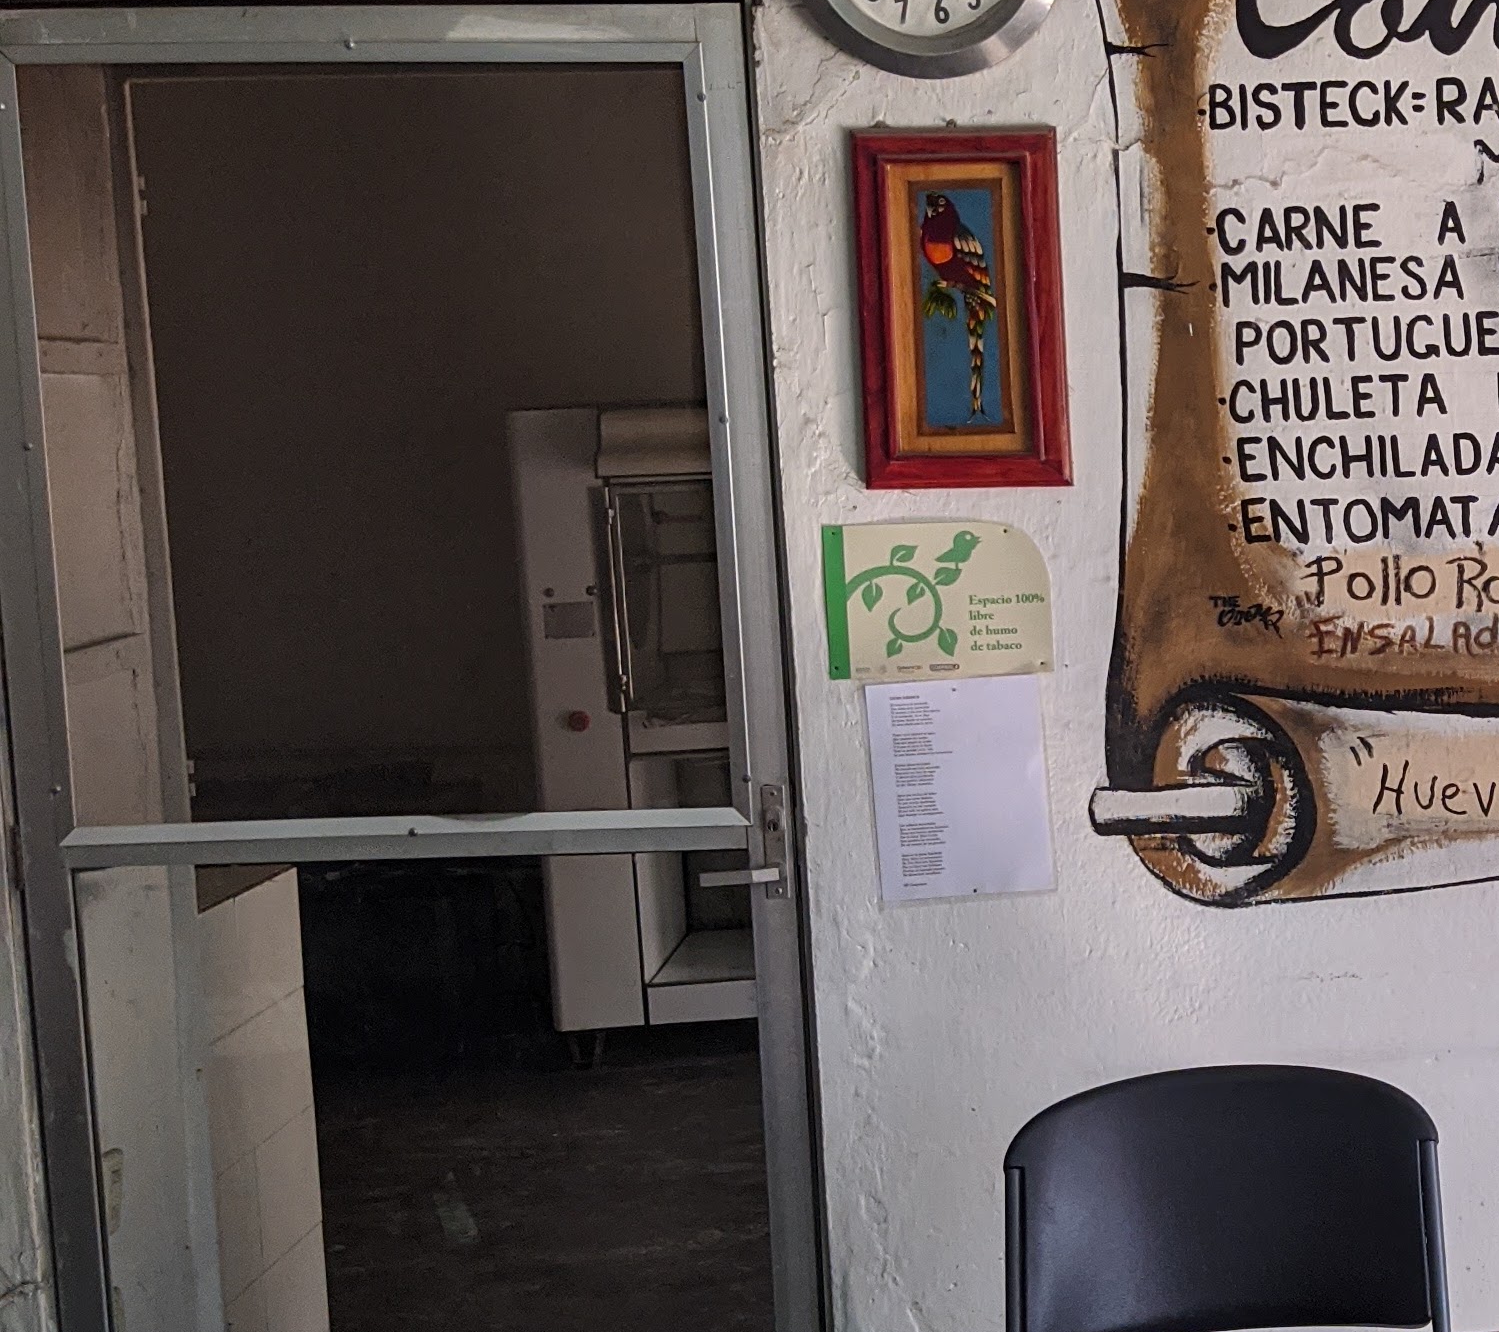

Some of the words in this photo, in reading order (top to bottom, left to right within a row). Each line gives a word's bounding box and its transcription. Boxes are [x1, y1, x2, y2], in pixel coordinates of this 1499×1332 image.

[1215, 202, 1383, 256] CARNE
[1437, 200, 1467, 245] A
[1221, 254, 1465, 308] MILANESA
[1229, 372, 1448, 424] CHULETA
[1301, 554, 1437, 607] Pollo
[968, 594, 1012, 608] Espacio
[1015, 593, 1045, 604] 100%
[968, 610, 995, 621] libre
[969, 625, 983, 636] de
[985, 625, 1018, 635] humo
[970, 640, 984, 651] de
[986, 639, 1023, 651] tabaco
